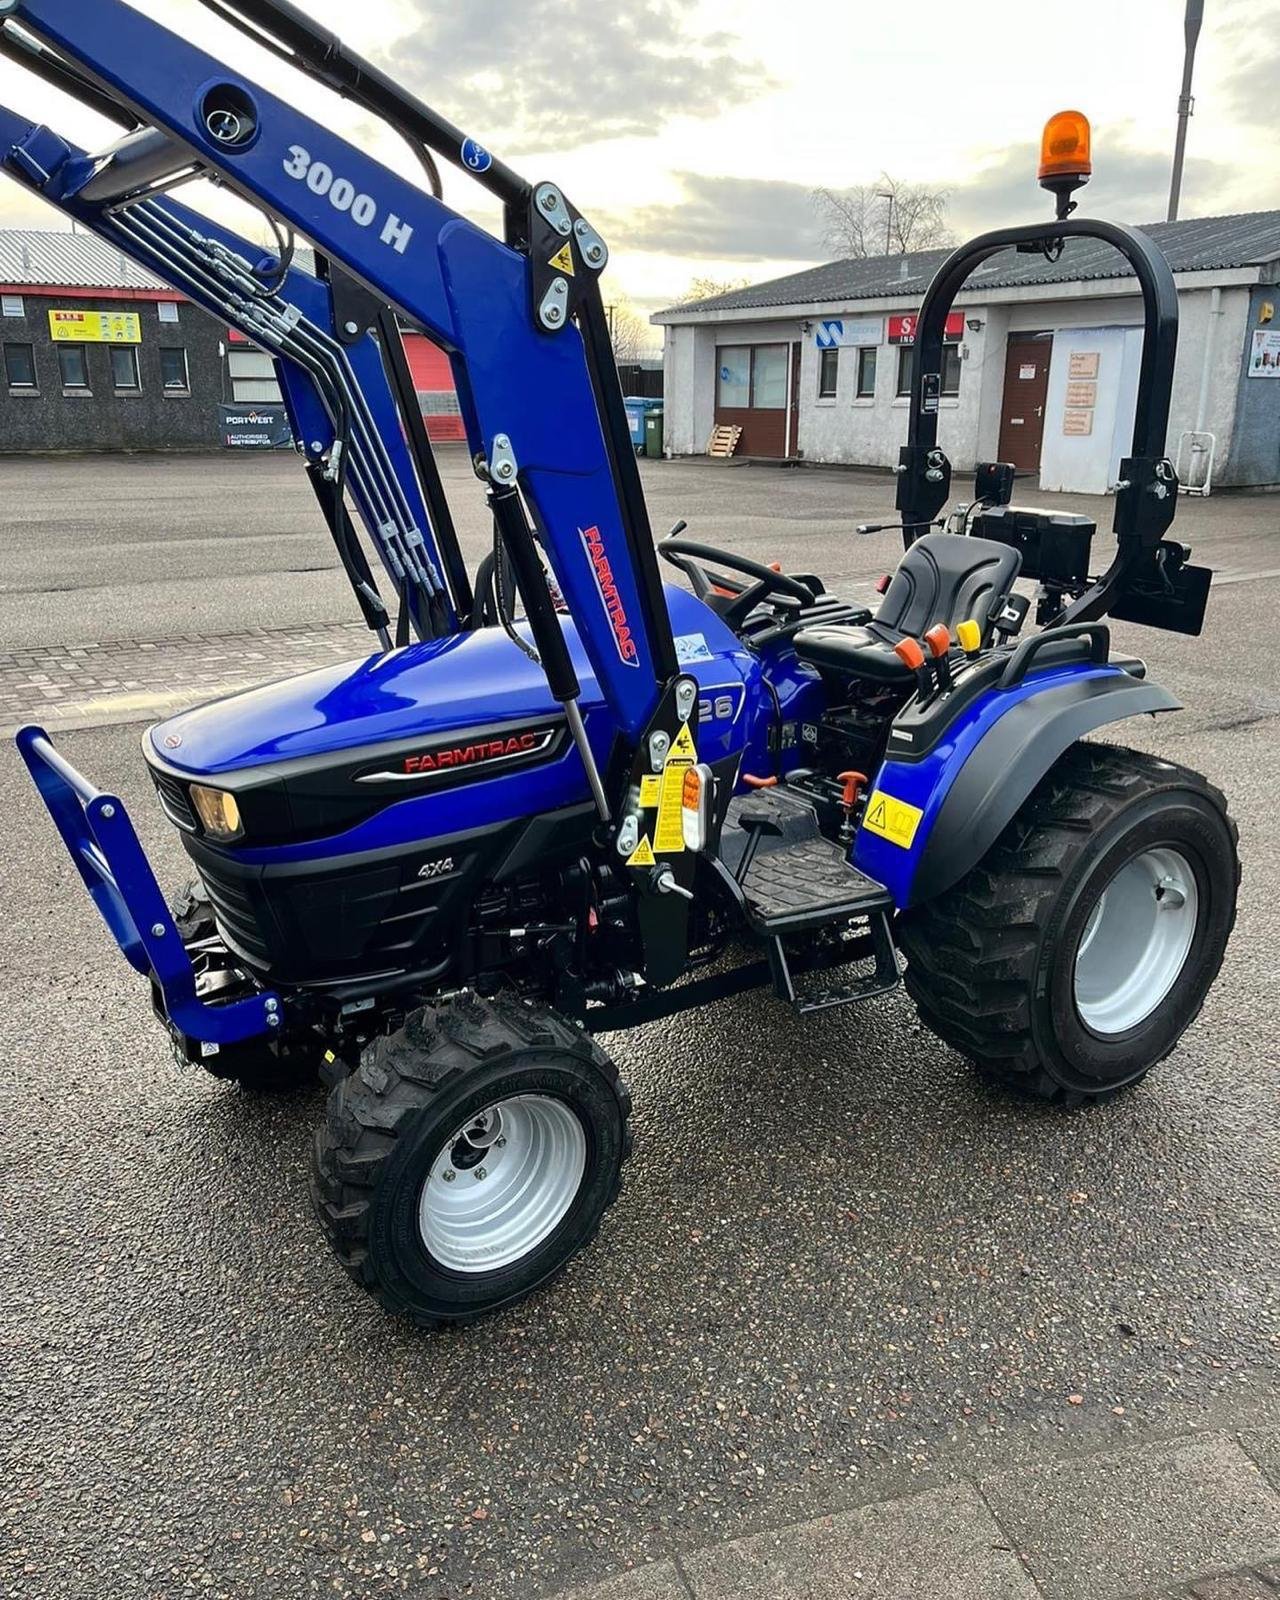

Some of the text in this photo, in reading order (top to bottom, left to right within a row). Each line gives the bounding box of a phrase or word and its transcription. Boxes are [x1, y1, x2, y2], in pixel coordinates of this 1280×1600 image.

[283, 145, 414, 254] 3000 H
[226, 416, 274, 425] PORTWEST
[584, 525, 636, 659] FARMTRAC
[699, 695, 733, 722] 26
[404, 732, 536, 773] FARMTRAC
